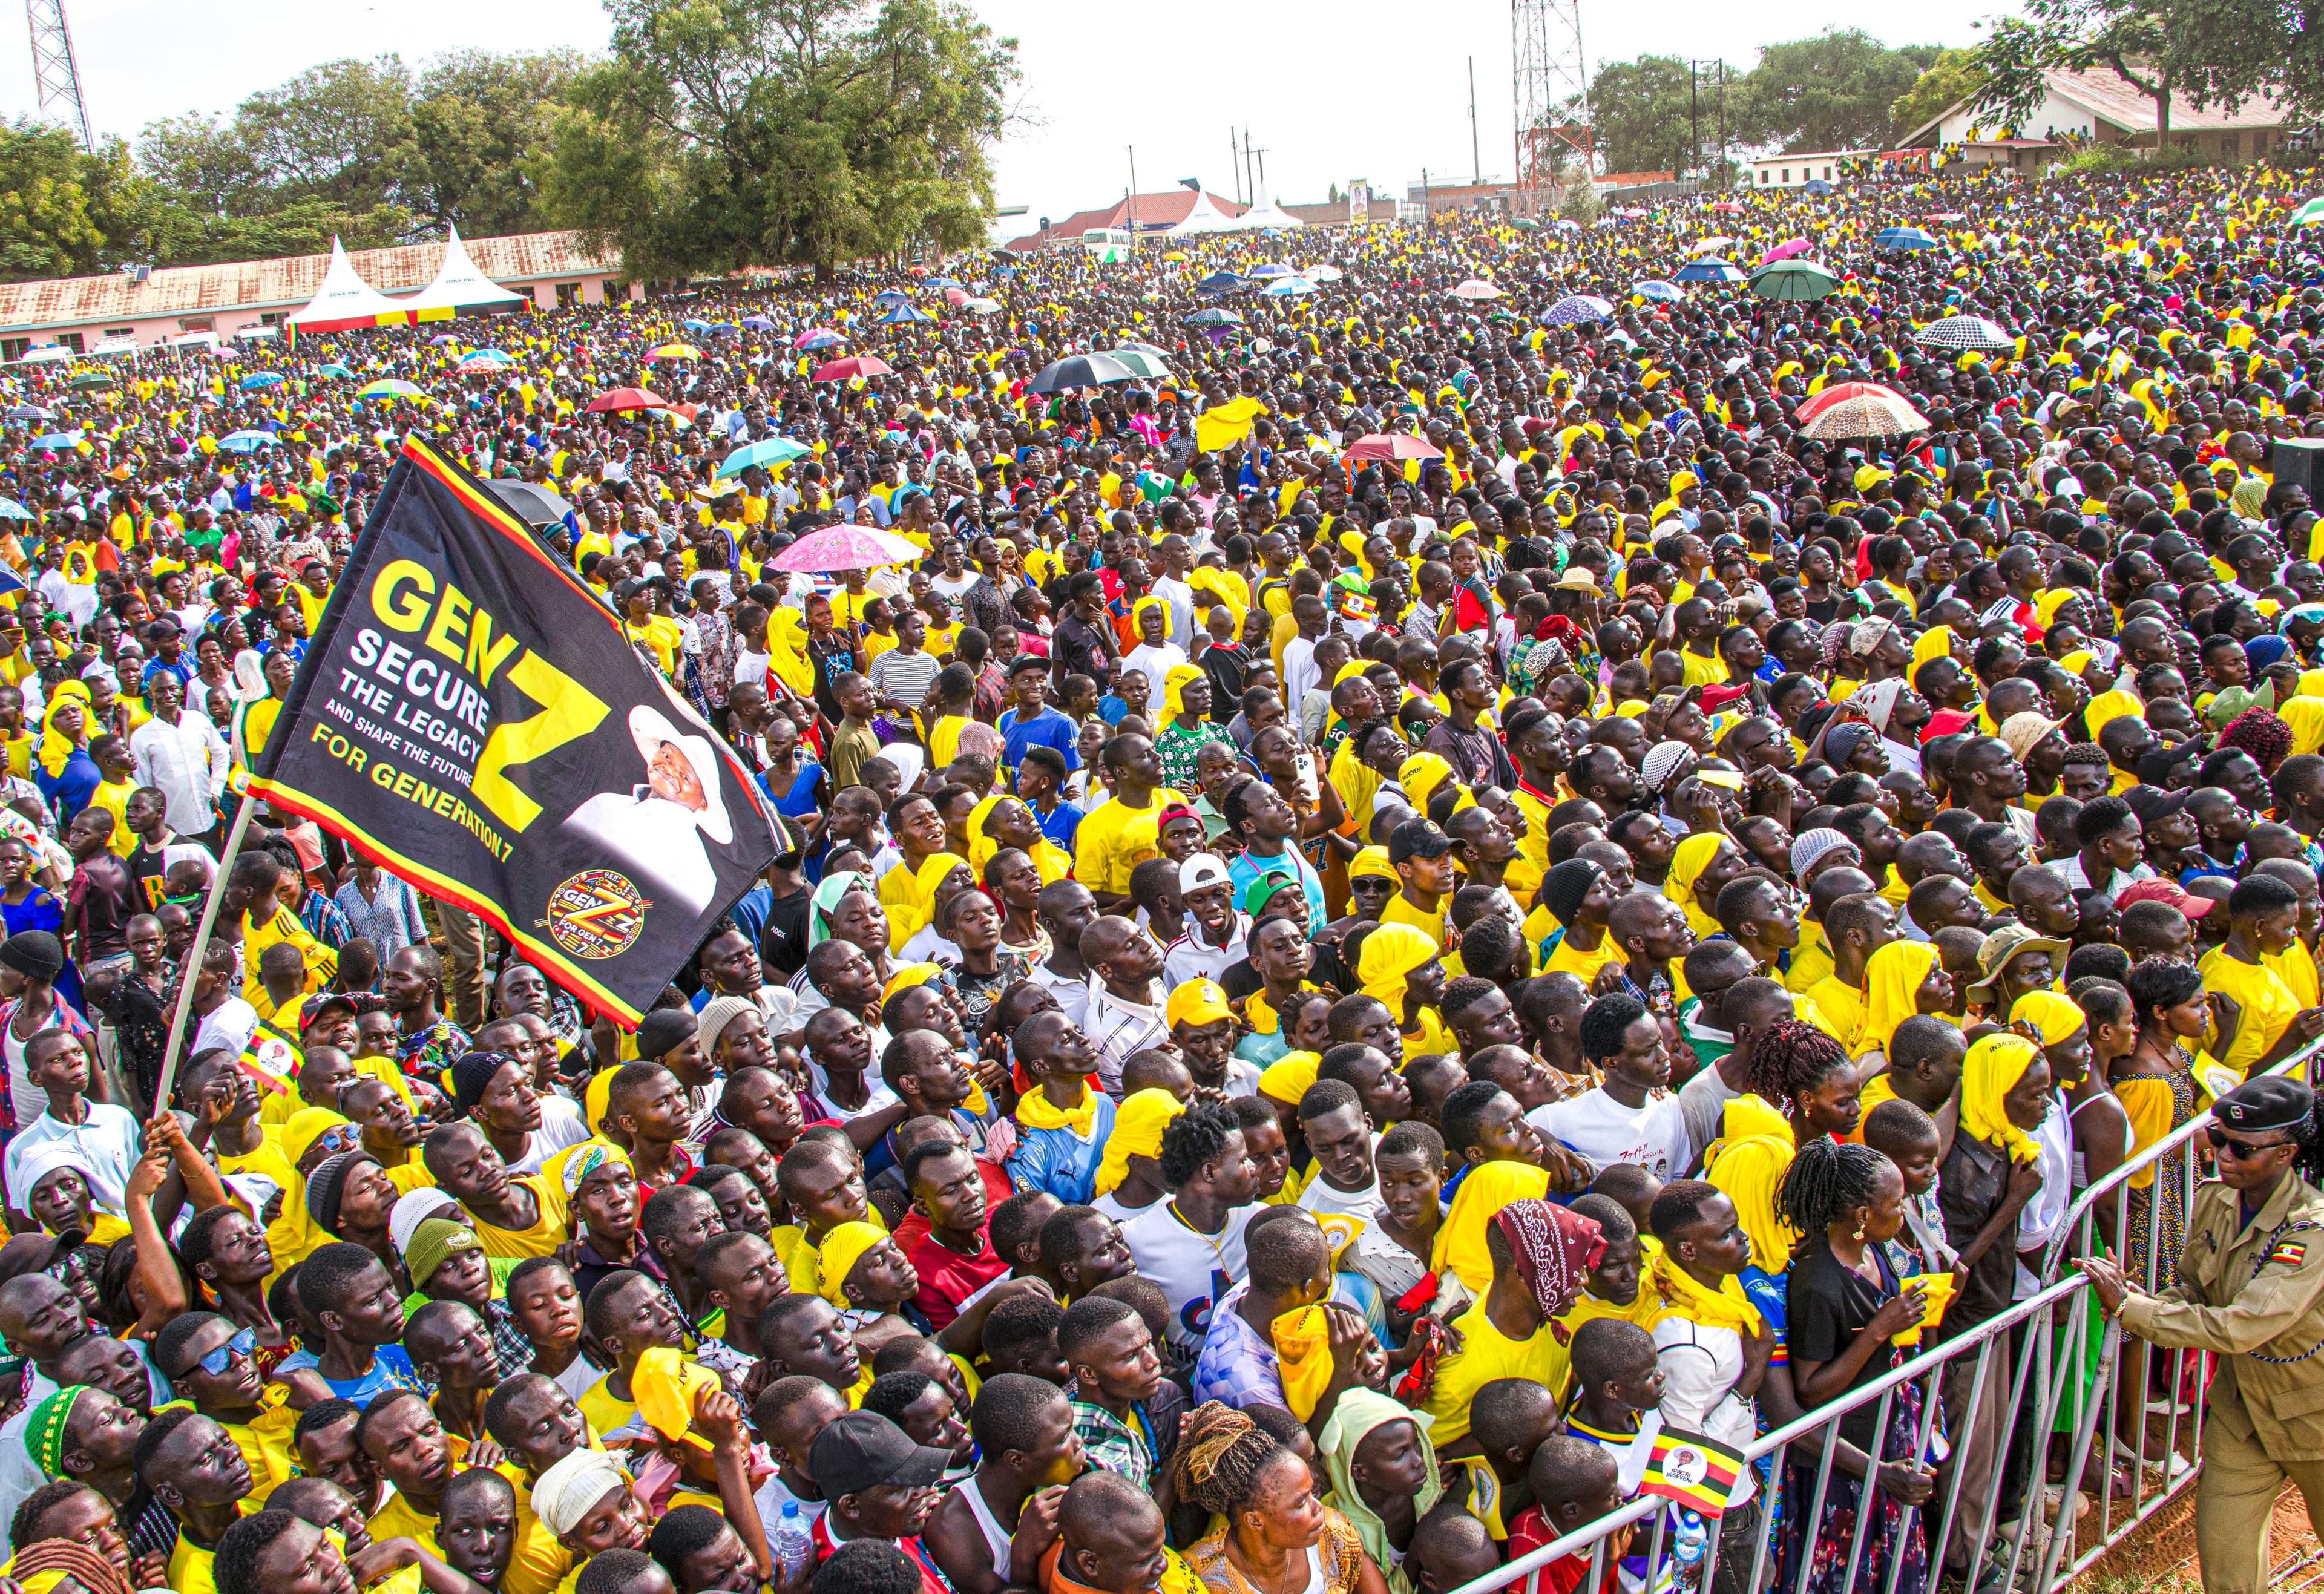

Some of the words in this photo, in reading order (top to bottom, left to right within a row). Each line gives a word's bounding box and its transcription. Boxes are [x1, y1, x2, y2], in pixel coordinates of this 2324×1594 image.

[349, 628, 490, 737] SECURE
[370, 559, 520, 689] GEN
[468, 648, 612, 834] Z
[338, 667, 393, 715] THE
[393, 701, 482, 764] LEGACY
[324, 698, 354, 723] AND
[354, 716, 402, 750] SHAPE
[402, 740, 431, 765] THE
[430, 755, 474, 789] FUTURE
[310, 721, 369, 773] FOR
[370, 762, 503, 858] GENERATION
[502, 842, 514, 864] 7
[563, 889, 603, 908] GEN
[563, 887, 632, 937] Z
[559, 919, 578, 934] FOR
[577, 928, 597, 942] GEN
[596, 937, 604, 945] 7
[971, 998, 991, 1012] GENIUS
[1666, 1472, 1693, 1484] MUSEVENI
[1671, 1468, 1691, 1478] YOWERI
